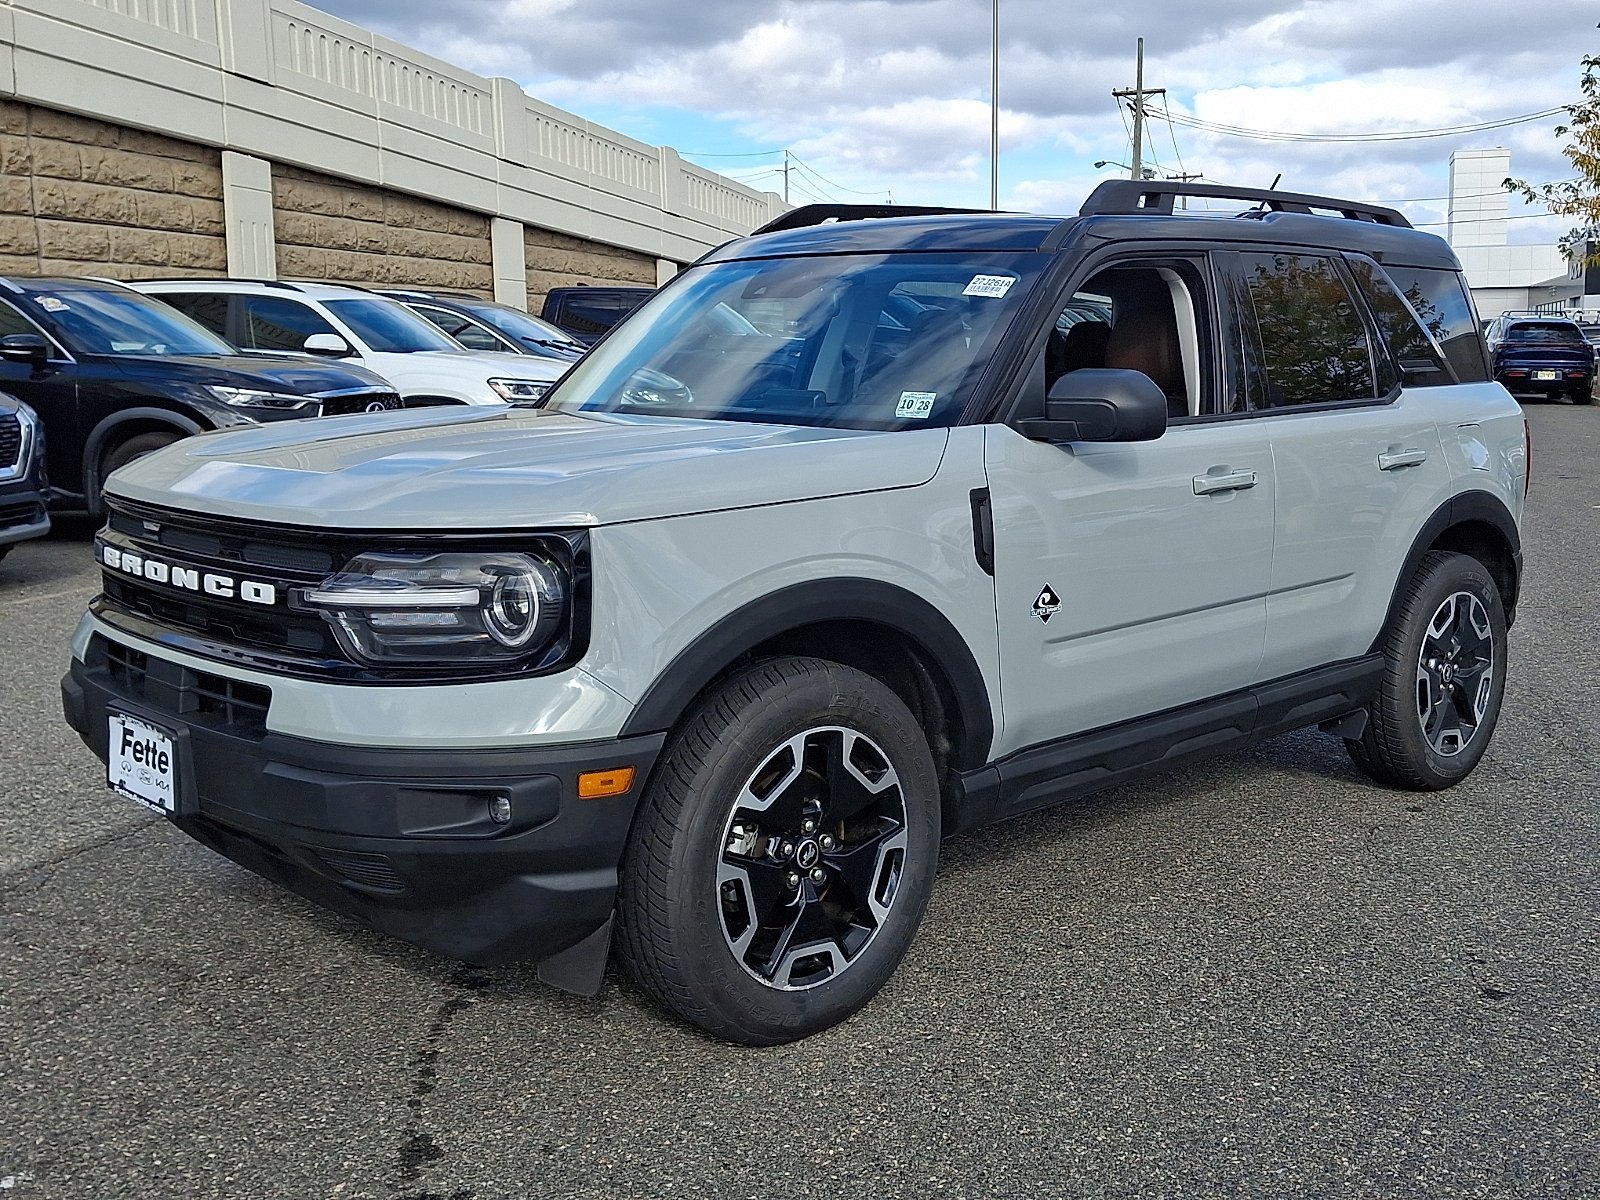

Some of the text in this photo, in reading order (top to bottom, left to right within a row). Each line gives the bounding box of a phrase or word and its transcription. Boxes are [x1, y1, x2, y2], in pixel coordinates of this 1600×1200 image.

[900, 399, 931, 411] 10 28
[103, 546, 275, 605] BRONCO
[120, 727, 169, 775] Fette
